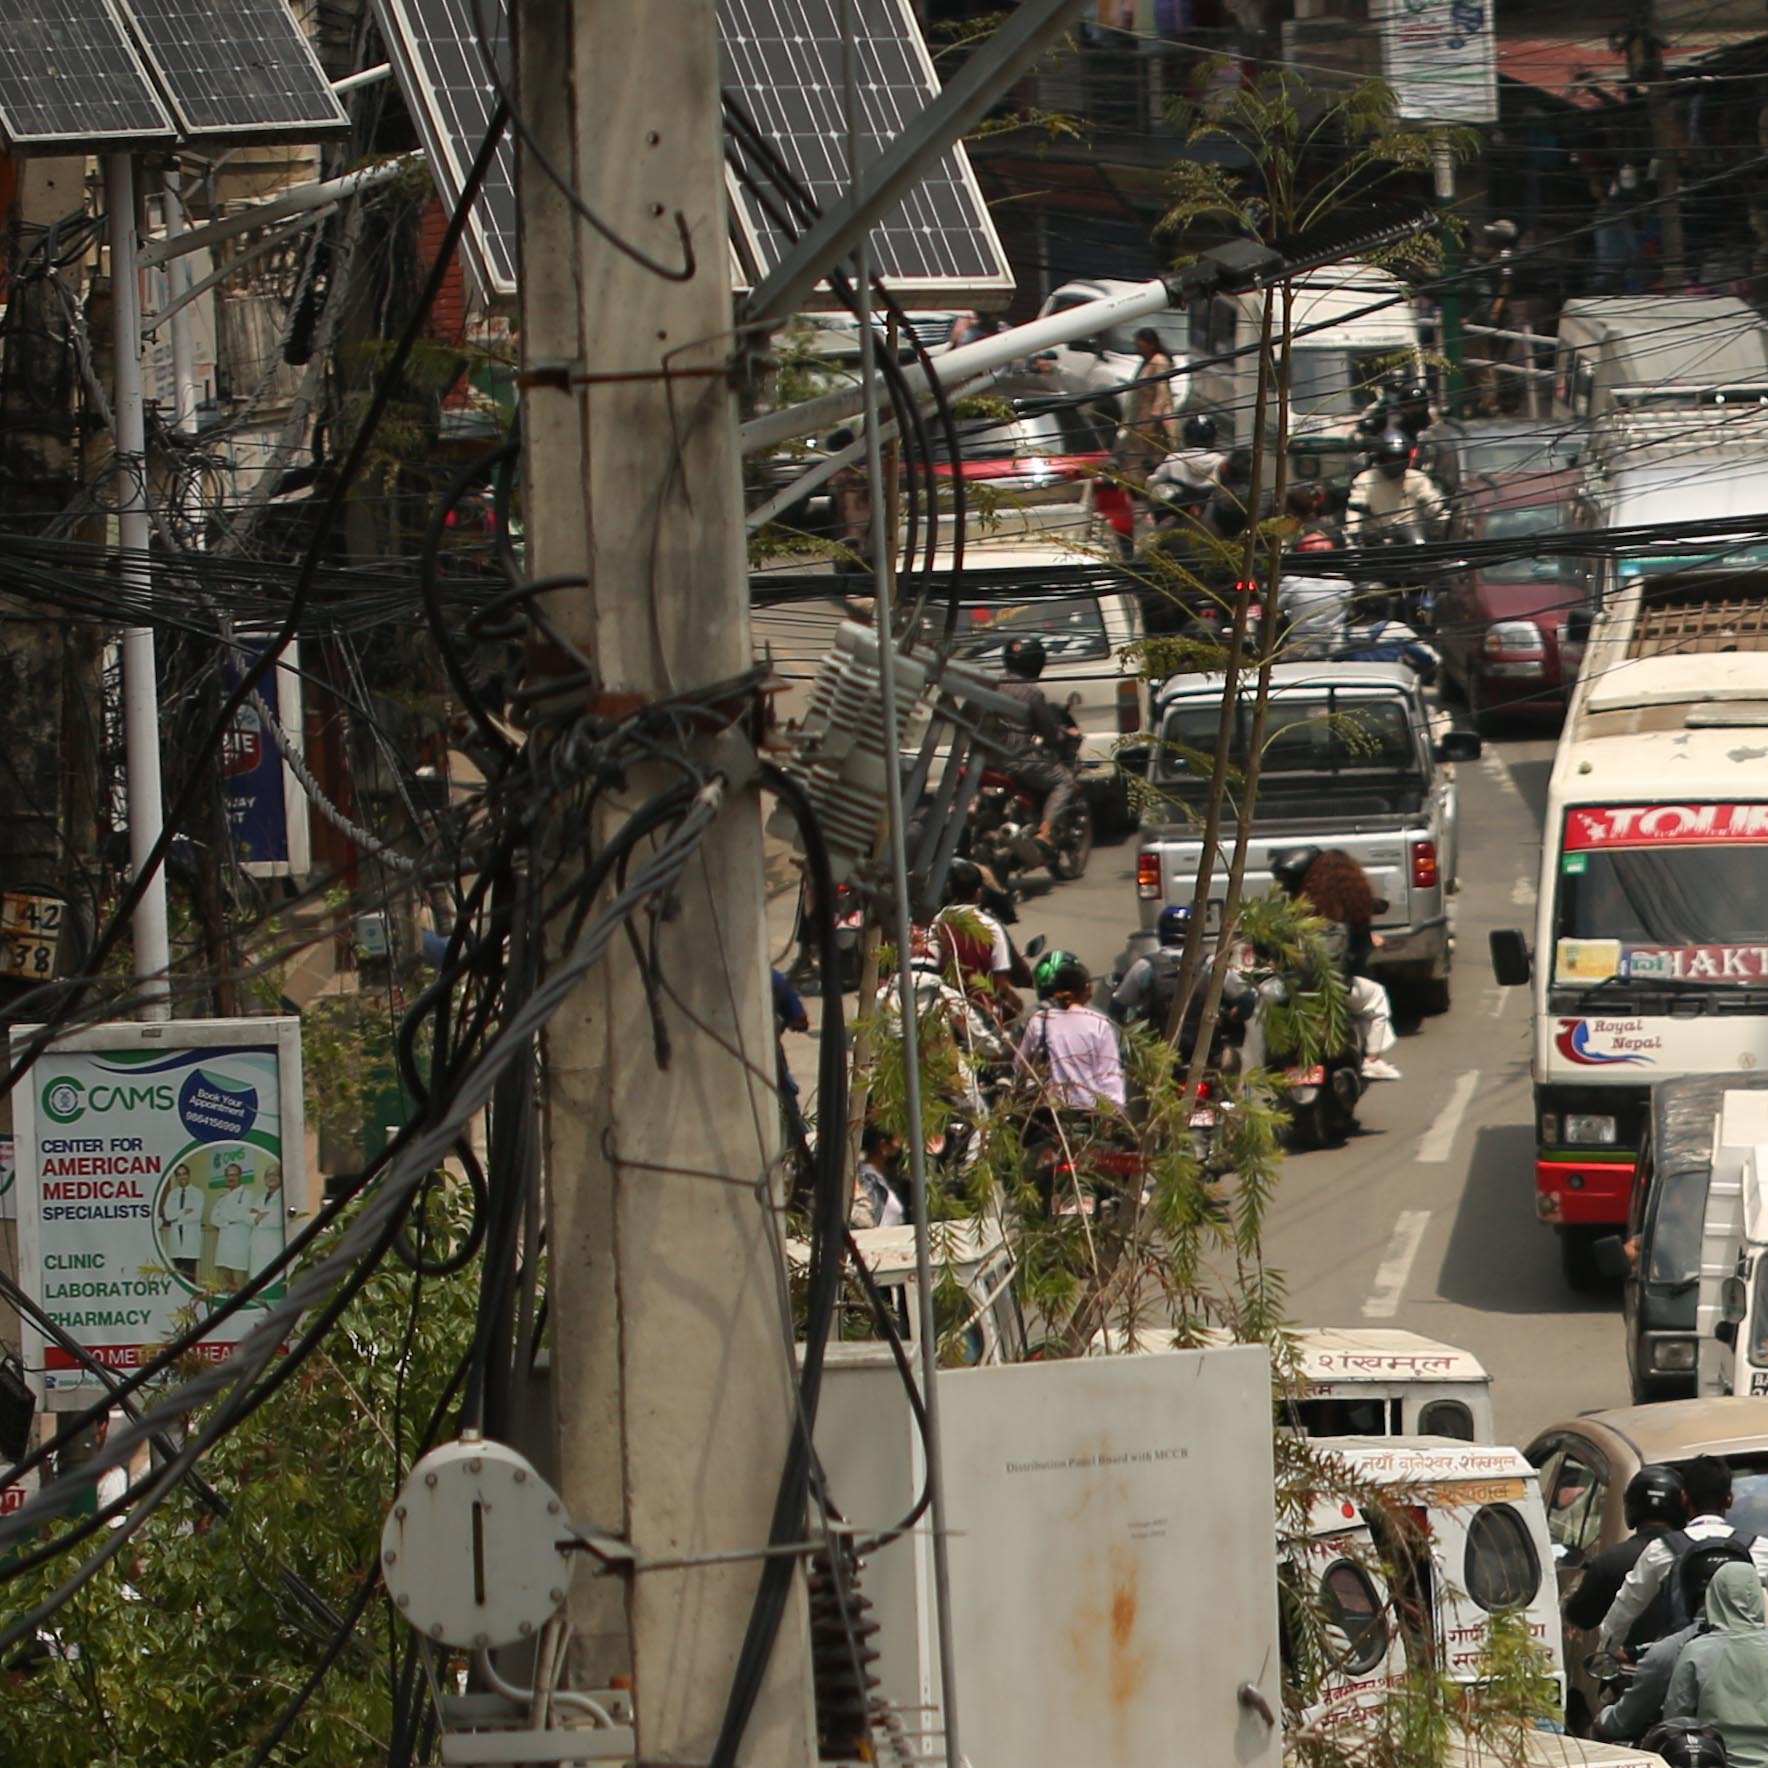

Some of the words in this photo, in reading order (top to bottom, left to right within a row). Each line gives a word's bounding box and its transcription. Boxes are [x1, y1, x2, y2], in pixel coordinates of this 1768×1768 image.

[1594, 1019, 1644, 1038] Royal
[1612, 1035, 1664, 1055] Nepal
[88, 1085, 175, 1112] CAMS
[189, 1095, 246, 1118] Appointment
[197, 1088, 221, 1103] Book
[222, 1093, 246, 1109] Your
[41, 1138, 104, 1154] CENTER
[110, 1138, 143, 1153] FOR
[42, 1156, 161, 1177] AMERICAN
[43, 1180, 144, 1200] MEDICAL
[42, 1204, 151, 1221] SPECIALISTS
[44, 1253, 105, 1270] CLINIC
[45, 1280, 172, 1299] LABORATORY
[47, 1309, 152, 1328] PHARMACY
[1318, 1351, 1459, 1376] शंखमूल
[1098, 1453, 1128, 1466] Board
[1131, 1451, 1152, 1463] with
